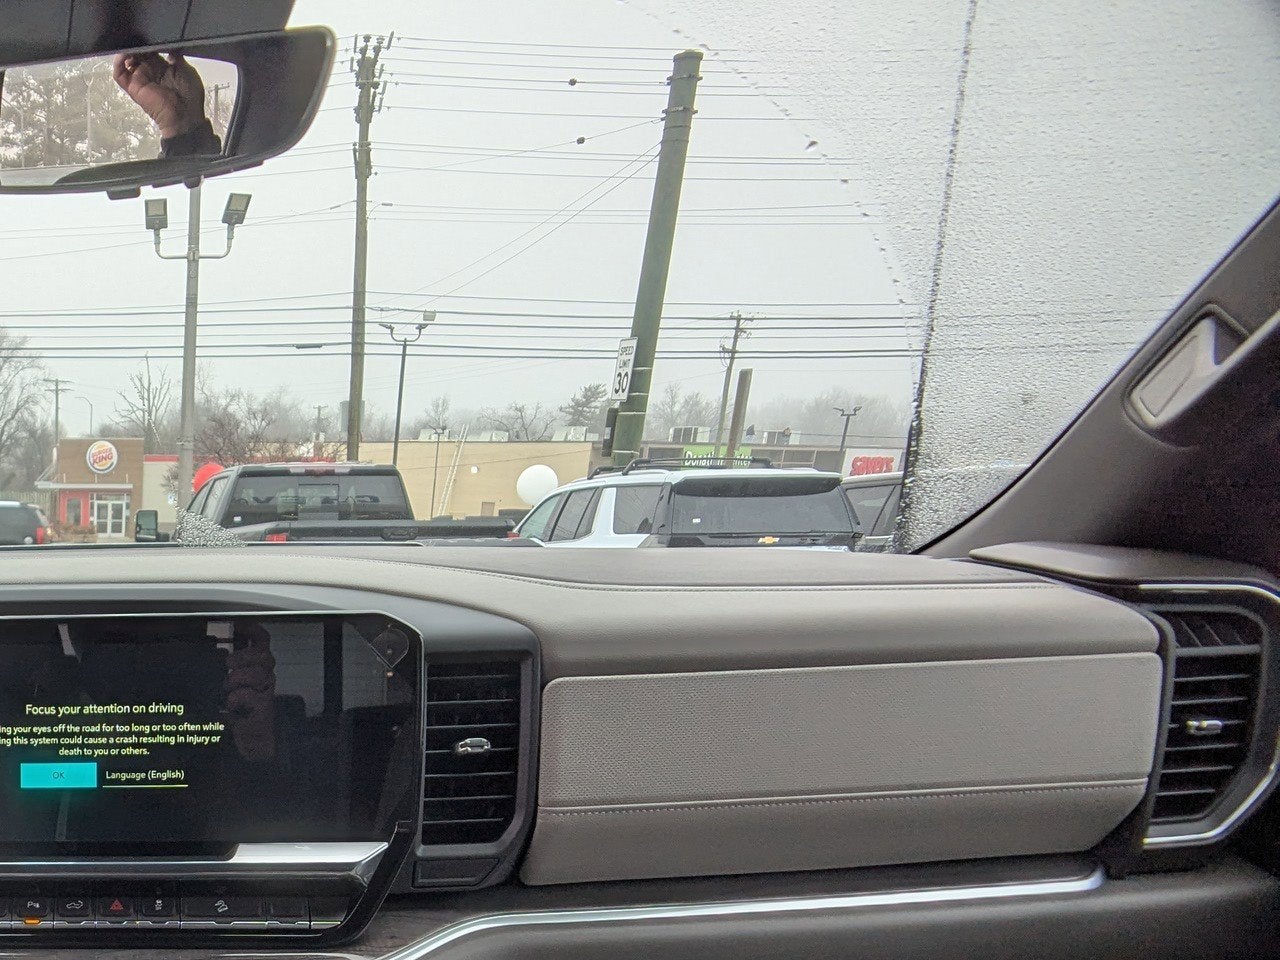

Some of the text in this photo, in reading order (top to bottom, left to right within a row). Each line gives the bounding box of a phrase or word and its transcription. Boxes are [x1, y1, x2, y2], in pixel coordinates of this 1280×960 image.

[614, 371, 629, 395] 30
[93, 453, 113, 466] KING
[25, 702, 184, 717] Focus your attention on driving
[13, 725, 31, 735] your
[33, 725, 51, 735] eyes
[53, 723, 65, 732] off
[66, 723, 80, 732] the
[82, 723, 101, 732] road
[102, 723, 114, 732] for
[116, 724, 130, 732] too
[131, 723, 150, 733] long
[152, 724, 161, 732] or
[162, 723, 177, 731] too
[178, 722, 201, 731] often
[202, 722, 225, 731] while
[13, 736, 28, 745] this
[30, 736, 59, 746] system
[60, 735, 82, 744] could
[83, 736, 107, 744] cause
[108, 736, 114, 744] a
[115, 735, 138, 743] crash
[139, 734, 175, 745] resulting
[177, 734, 185, 743] in
[186, 734, 210, 745] injury
[211, 735, 221, 743] or
[59, 747, 82, 756] death
[93, 748, 109, 757] you
[121, 747, 150, 755] others.
[52, 771, 65, 780] OK
[105, 770, 185, 781] Language (English)
